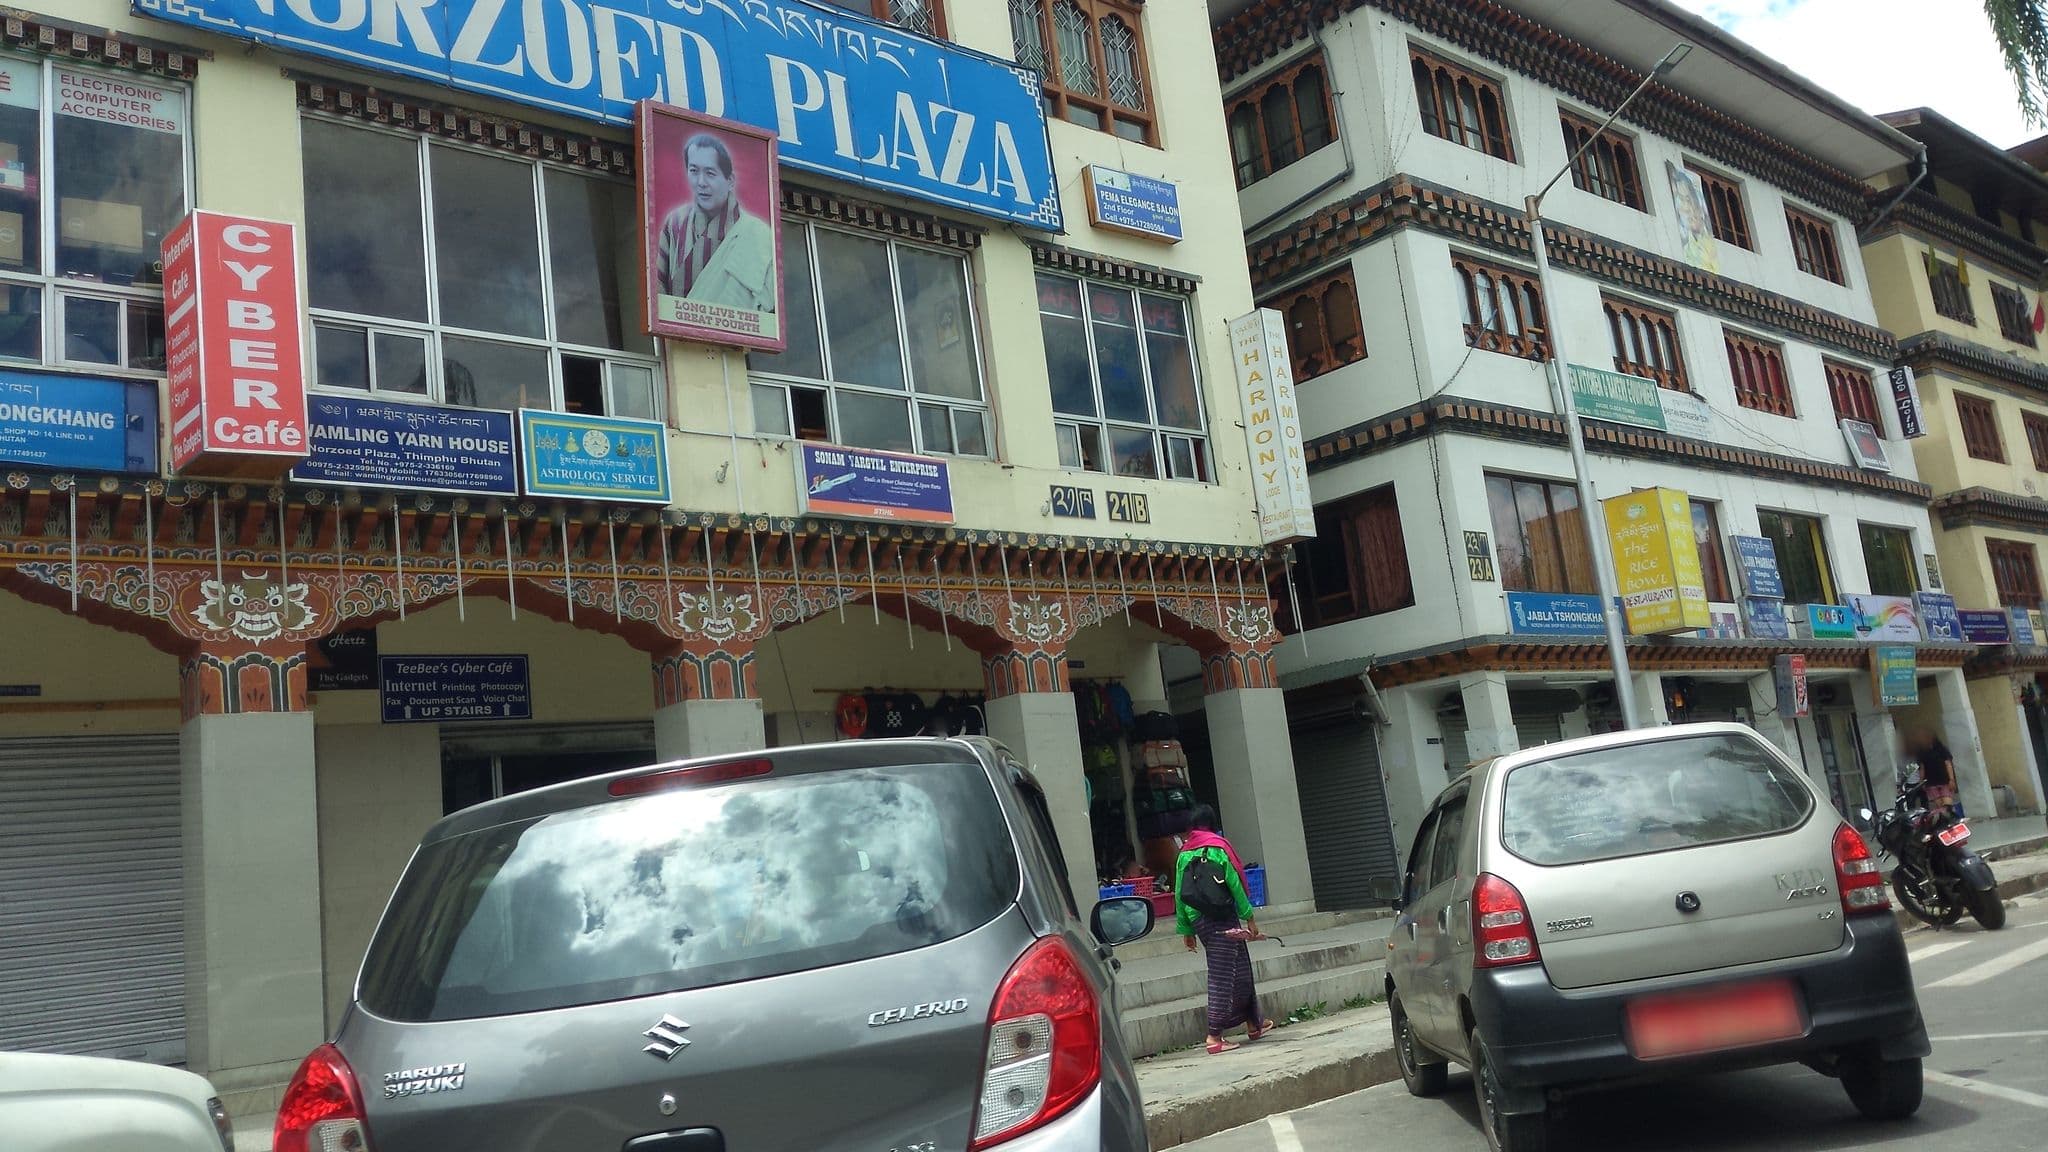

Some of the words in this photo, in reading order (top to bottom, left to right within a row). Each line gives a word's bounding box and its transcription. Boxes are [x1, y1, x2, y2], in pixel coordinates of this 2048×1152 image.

[60, 73, 163, 102] ELECTRONIC
[61, 88, 152, 114] COMPUTER
[209, 0, 724, 118] RZOED
[765, 53, 1035, 206] PLAZA
[61, 102, 176, 131] ACCESSORIES
[1100, 190, 1120, 205] PEMA
[1120, 195, 1156, 212] ELEGANCE
[1156, 203, 1179, 217] SALON
[1103, 202, 1117, 211] 2nd
[1117, 205, 1135, 215] Floor
[163, 226, 194, 270] Internet
[171, 268, 190, 300] Café
[222, 224, 283, 410] CYBER
[674, 300, 707, 314] LONG
[709, 306, 735, 319] LIVE
[737, 311, 760, 323] THE
[675, 311, 713, 326] GREAT
[715, 318, 760, 333] FOURTH
[0, 404, 115, 430] ONGKHANG
[1242, 348, 1278, 484] HARMONY
[1273, 346, 1301, 480] HARMONY
[0, 435, 26, 443] HUTAN
[4, 427, 26, 435] SHOP
[213, 416, 302, 446] Café
[394, 431, 443, 450] YARN
[449, 437, 509, 455] HOUSE
[308, 443, 361, 456] Norzoed
[364, 448, 401, 460] Plaza,
[404, 451, 457, 463] Thimphu
[460, 456, 501, 467] Bhutan
[377, 459, 391, 467] No.
[815, 451, 845, 466] SONAM
[889, 460, 939, 478] ENTERPRISE
[324, 469, 353, 477] Email:
[354, 472, 488, 487] wamlingyarnhouse@gmail.com
[540, 468, 609, 481] ASTROLOGY
[612, 473, 657, 485] SERVICE
[1630, 558, 1659, 574] RICE
[1626, 574, 1668, 591] BOWL
[1625, 588, 1674, 607] RESTAURANT
[1526, 611, 1554, 621] JABLA
[1554, 611, 1605, 623] TSHONGKHA
[396, 663, 449, 674] TeeBee's
[451, 663, 486, 676] Cyber
[488, 661, 514, 674] Café
[385, 679, 437, 692] Internet
[442, 683, 476, 693] Printing
[480, 682, 526, 692] Photocopy
[386, 697, 402, 706] Fax
[409, 696, 455, 706] Document
[456, 695, 477, 705] Scan
[482, 694, 507, 704] Voice
[507, 693, 527, 703] Chat
[421, 707, 441, 717] UP
[444, 705, 493, 716] STAIRS
[867, 997, 969, 1028] CELERIO
[383, 1062, 467, 1083] MARUTI
[383, 1074, 465, 1100] SUZUKI
